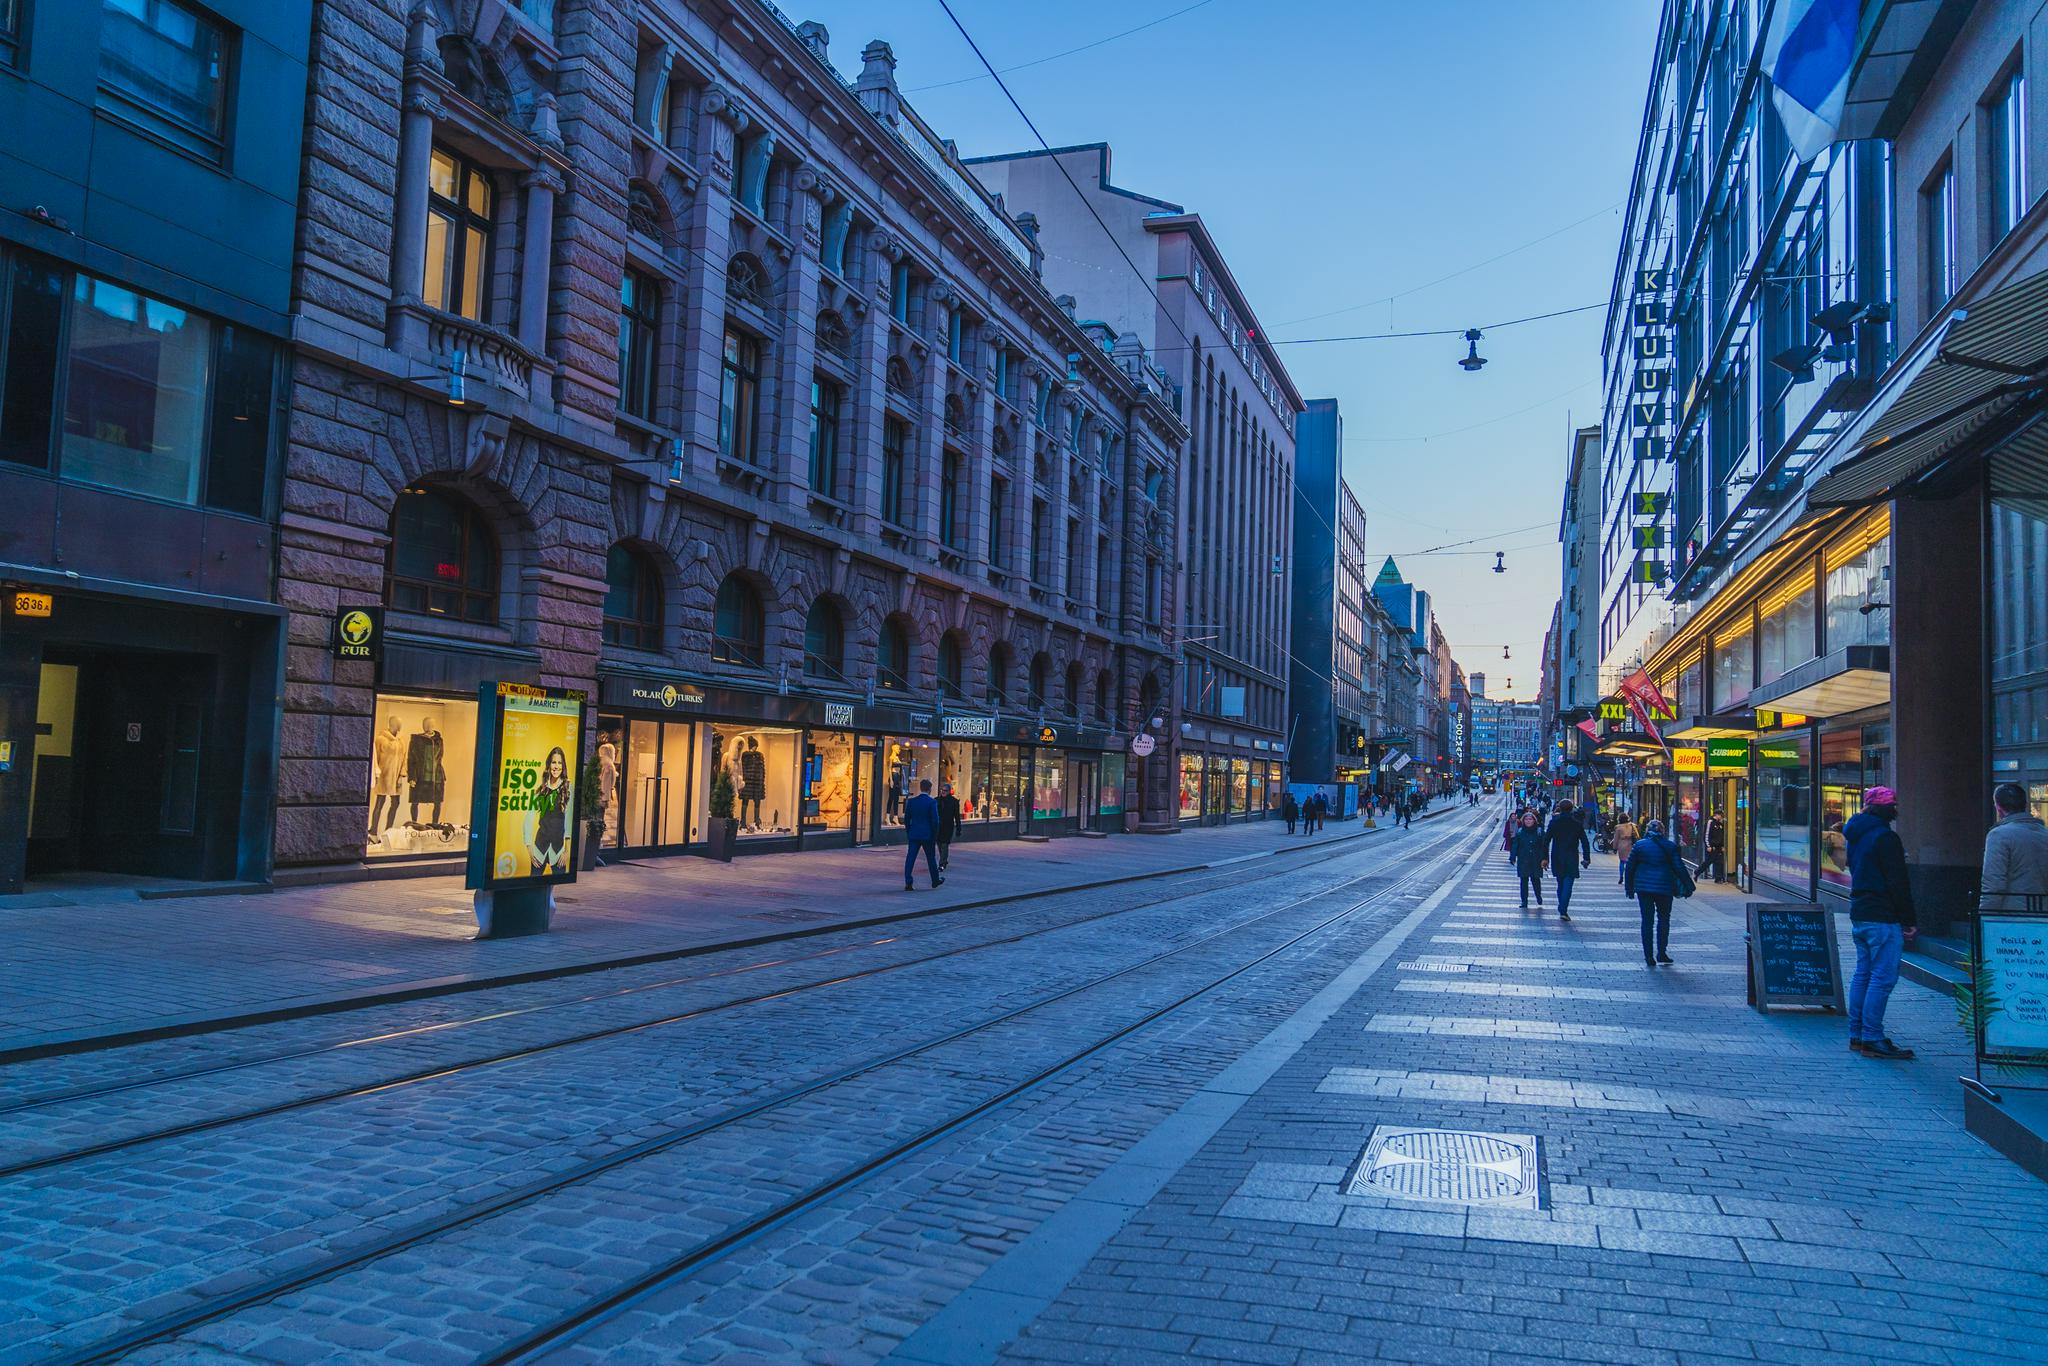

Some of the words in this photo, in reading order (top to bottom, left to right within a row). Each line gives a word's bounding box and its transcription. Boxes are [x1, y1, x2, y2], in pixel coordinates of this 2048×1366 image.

[1642, 272, 1658, 456] KLUUVI
[1641, 493, 1656, 582] XXL
[16, 597, 30, 610] 36
[31, 599, 42, 610] 36
[340, 645, 370, 656] FUR
[632, 688, 661, 699] POLAR
[677, 693, 703, 703] TURKIS
[1600, 703, 1626, 719] XXL
[954, 722, 985, 732] Wolford
[1710, 748, 1747, 757] SUBWAY
[512, 759, 524, 768] Nyt
[1677, 755, 1702, 765] alepa
[502, 759, 537, 789] iso
